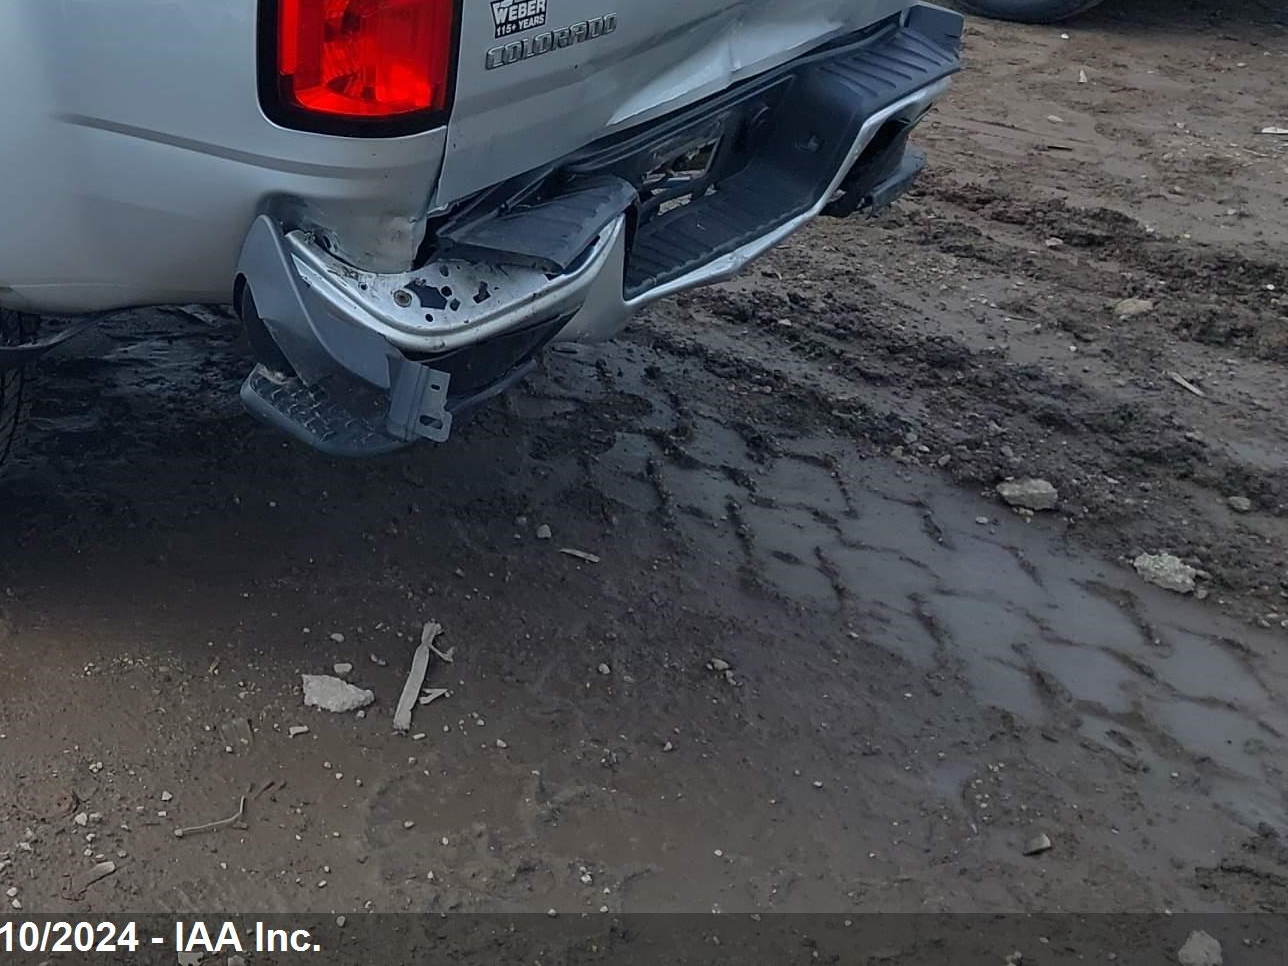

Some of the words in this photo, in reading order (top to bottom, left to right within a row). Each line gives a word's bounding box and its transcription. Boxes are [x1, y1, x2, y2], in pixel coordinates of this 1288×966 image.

[486, 12, 618, 70] COLORADO
[496, 24, 516, 36] 115+
[518, 14, 545, 30] YEARS
